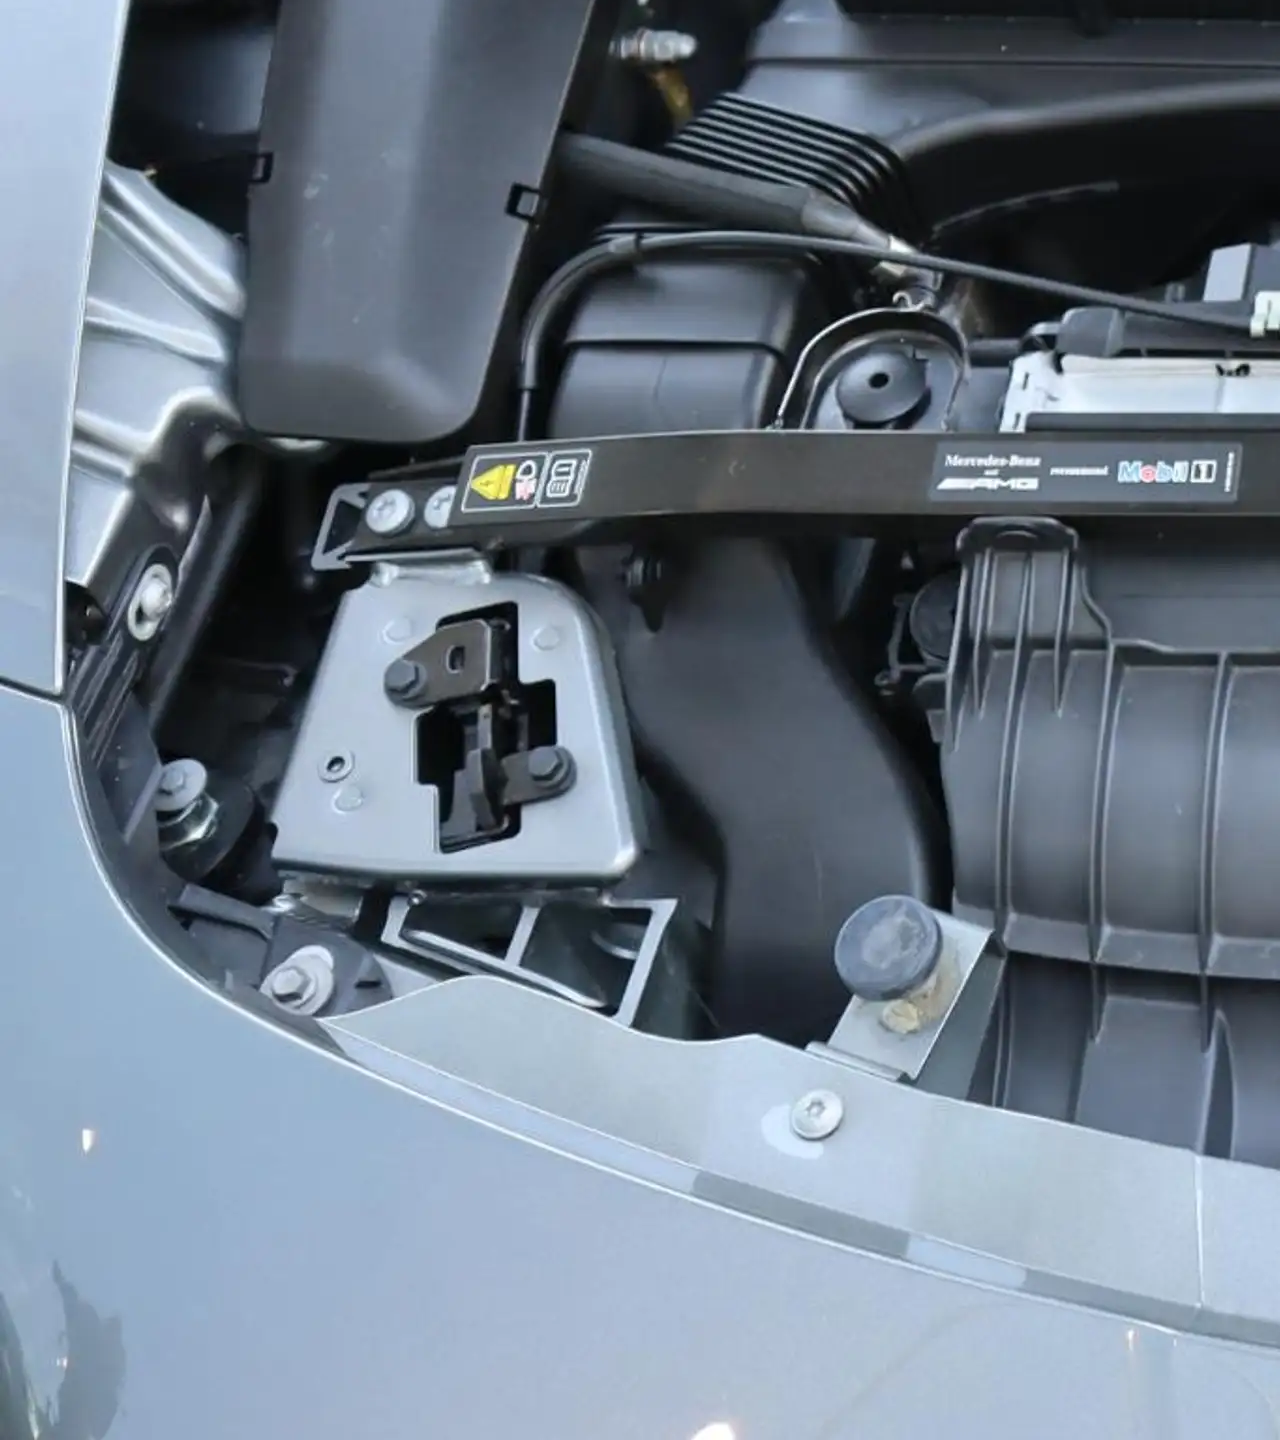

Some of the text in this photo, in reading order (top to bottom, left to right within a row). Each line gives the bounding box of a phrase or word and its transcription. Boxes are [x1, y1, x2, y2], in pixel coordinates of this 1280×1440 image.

[945, 453, 1042, 467] Mercedes-Benz
[1116, 460, 1190, 483] Mobil
[966, 477, 1040, 491] AMG
